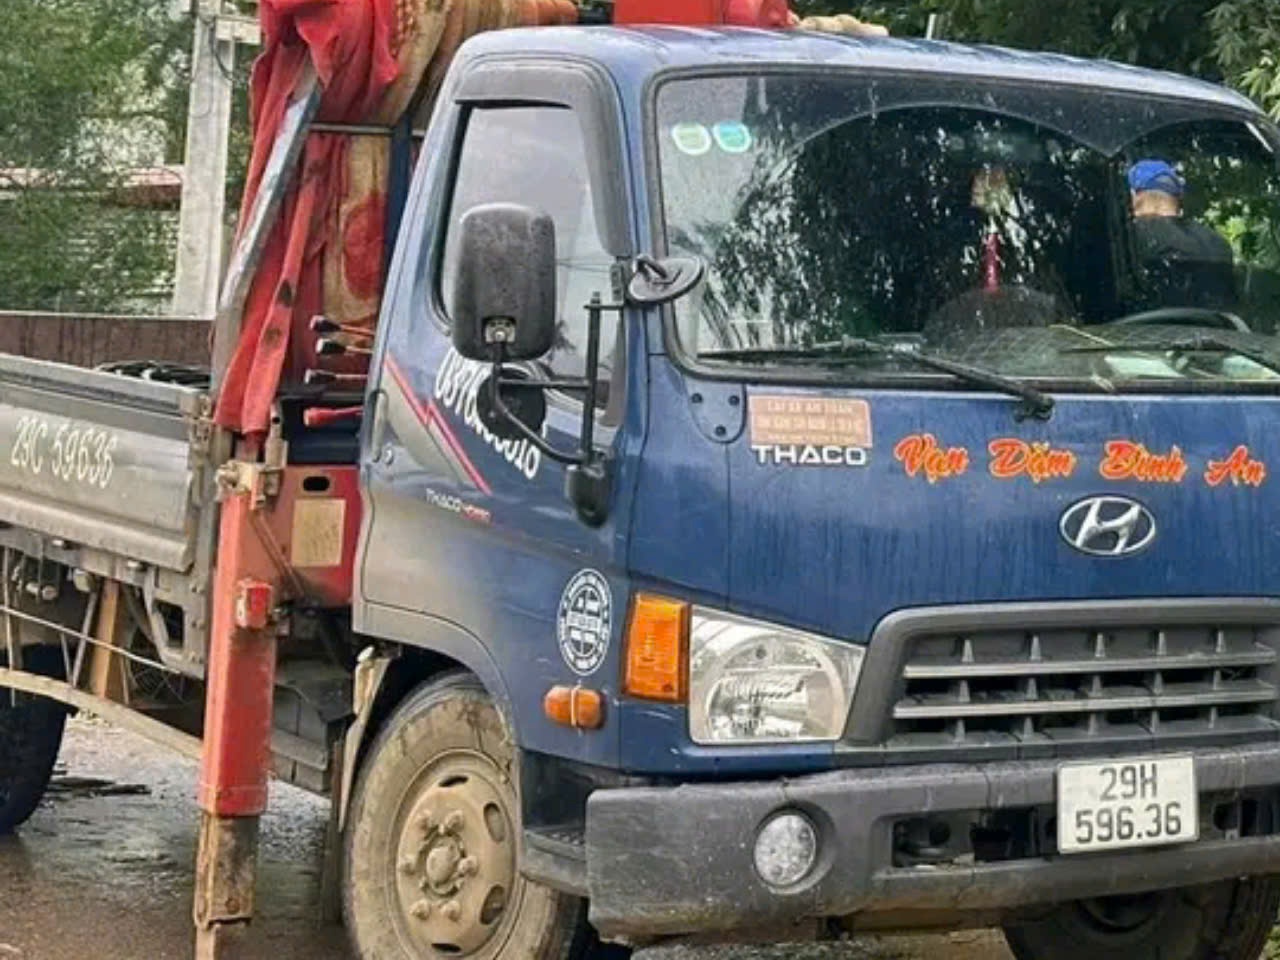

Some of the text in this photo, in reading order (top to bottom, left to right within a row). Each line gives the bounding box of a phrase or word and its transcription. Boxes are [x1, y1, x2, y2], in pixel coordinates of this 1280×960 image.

[11, 416, 118, 489] 29C 59636
[752, 444, 867, 465] THACO
[893, 433, 969, 483] Vạn
[988, 438, 1076, 483] Dặm
[1204, 444, 1266, 487] An
[1100, 763, 1157, 801] 29H
[1075, 801, 1181, 844] 596.36
